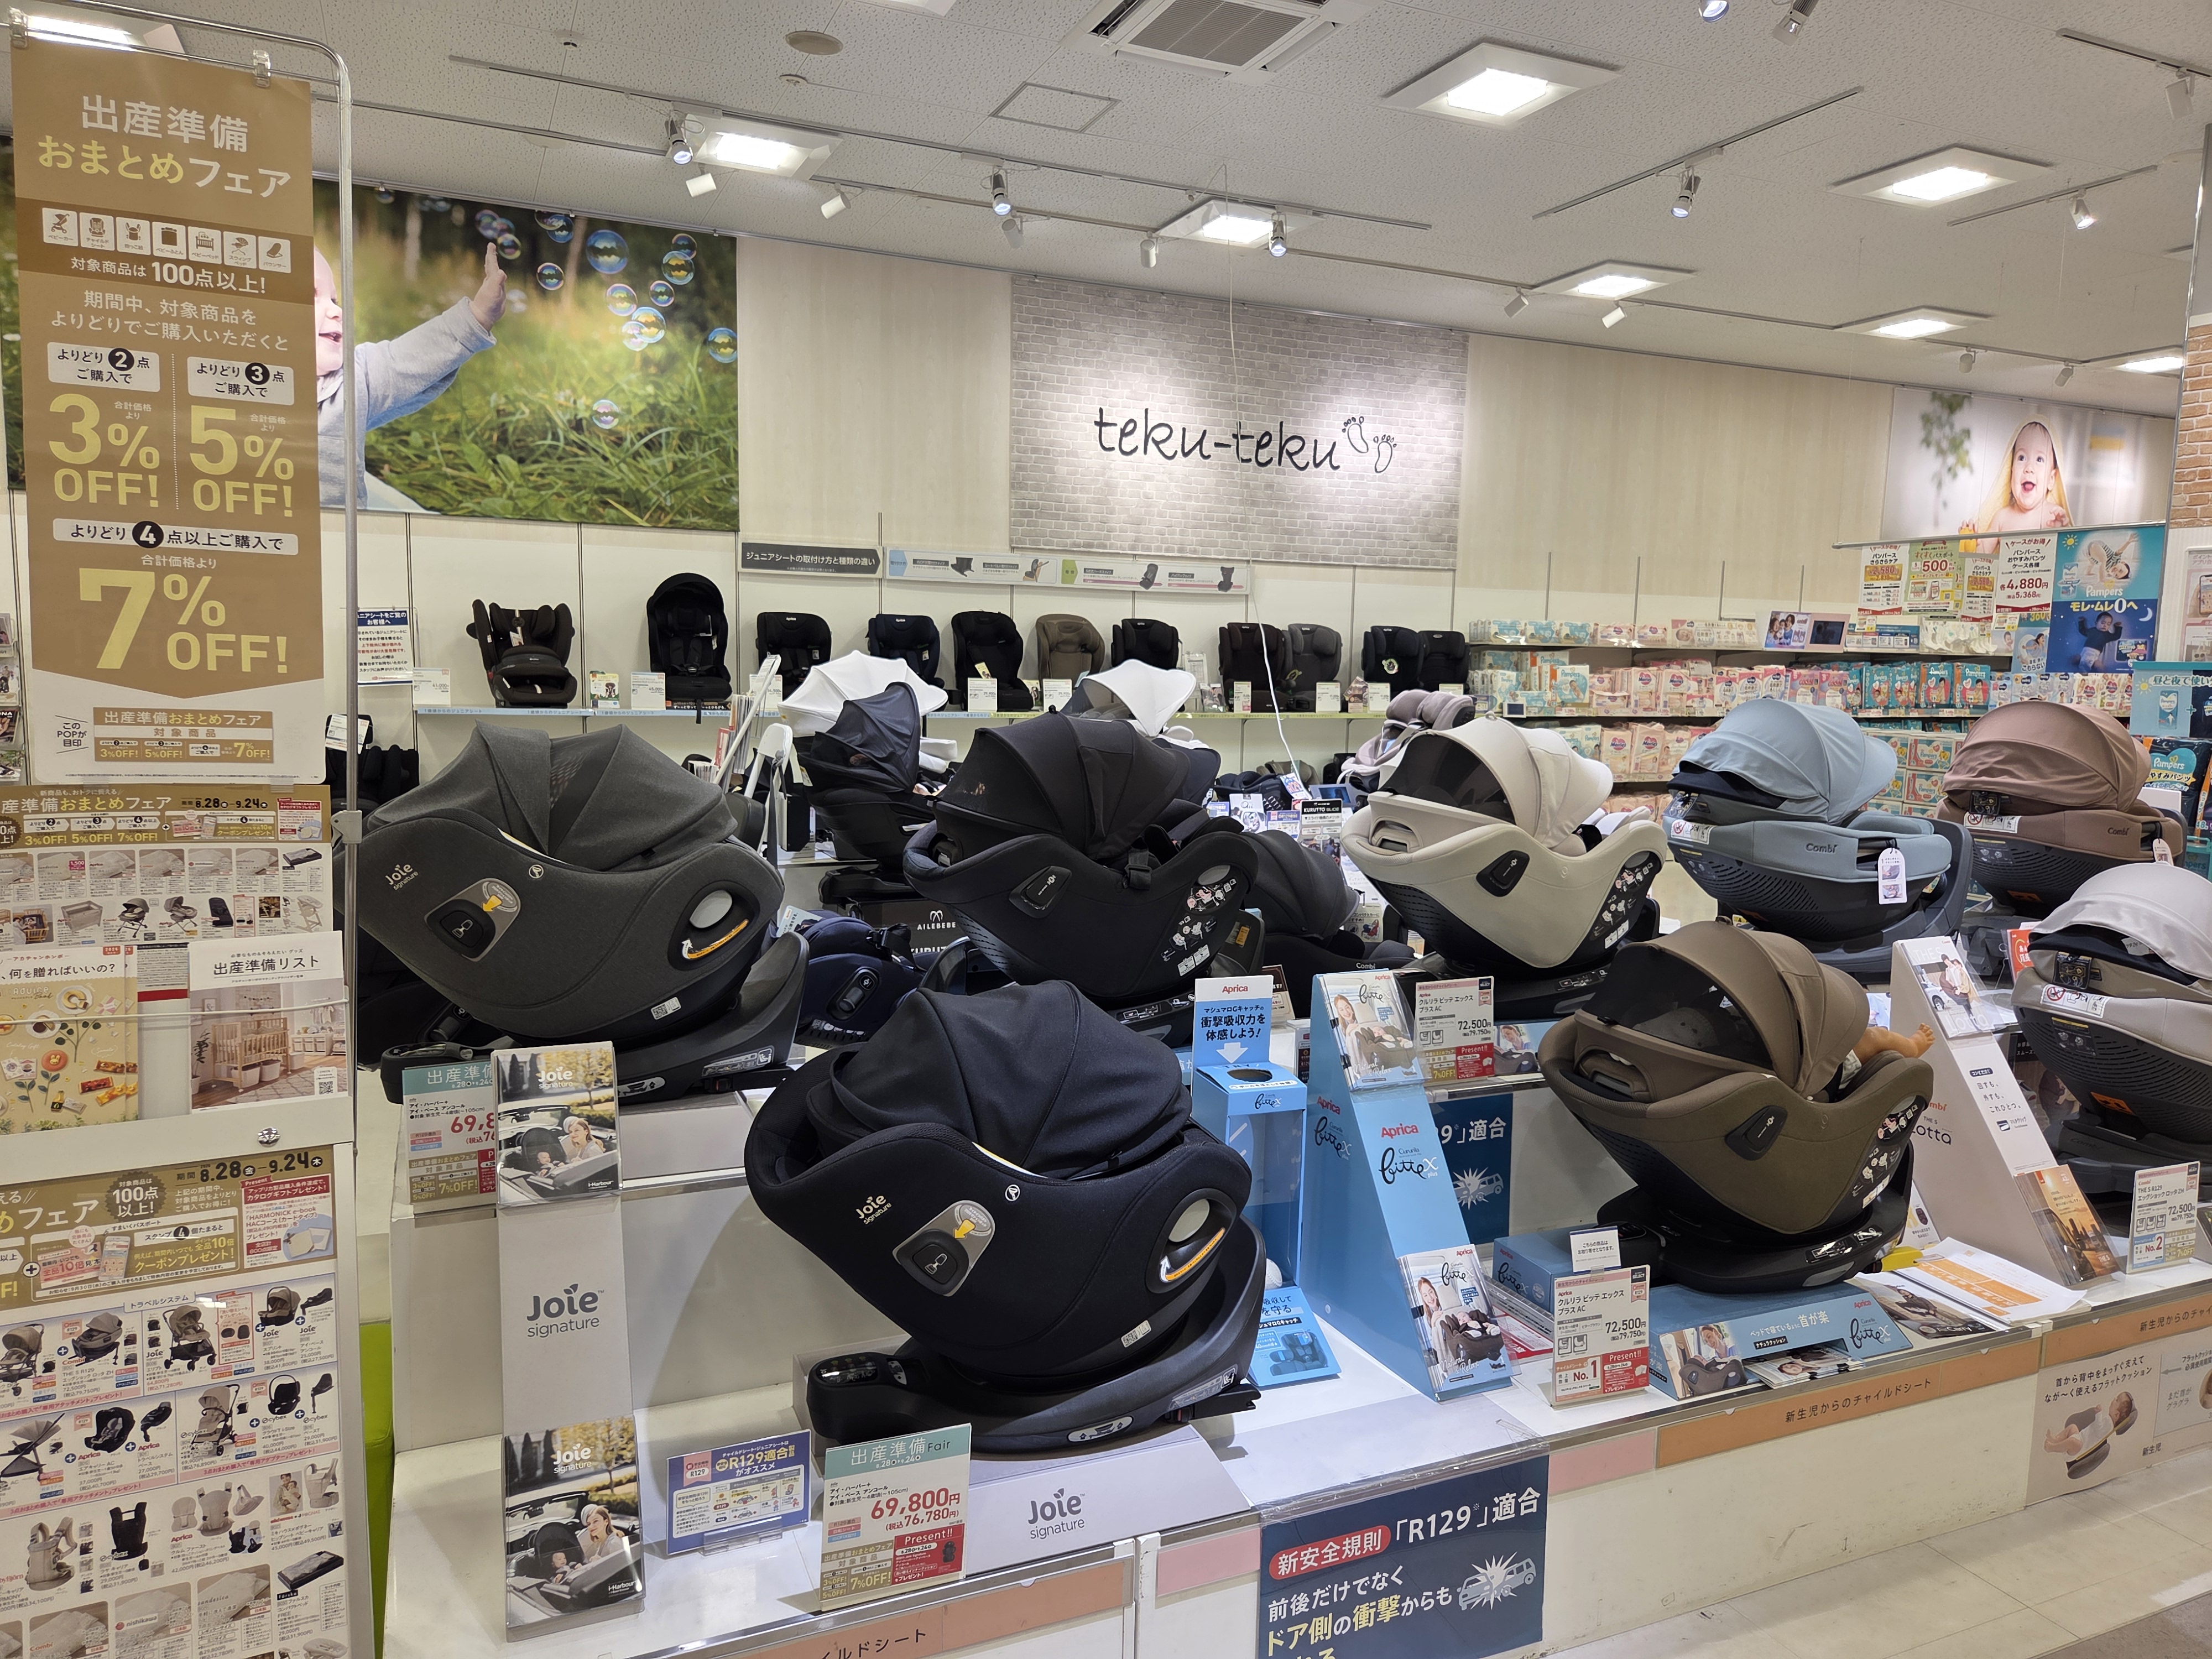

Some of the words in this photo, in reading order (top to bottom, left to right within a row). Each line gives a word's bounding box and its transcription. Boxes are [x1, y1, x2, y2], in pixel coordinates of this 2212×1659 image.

[82, 95, 248, 153] 出産準備
[38, 135, 291, 197] おまとめフェア
[84, 289, 257, 325] 期間中、対象商品を
[51, 310, 289, 351] よりどりでご購入いただくと
[76, 368, 133, 384] ご購入で
[215, 381, 269, 398] ご購入で
[113, 401, 152, 413] 合計価格
[249, 414, 287, 425] 合計価格
[49, 393, 160, 469] 3%
[190, 405, 295, 481] 5%
[1094, 407, 1340, 472] teku-teku
[54, 468, 159, 508] OFF!
[192, 479, 293, 518] OFF!
[2010, 538, 2046, 547] ケースがお得
[141, 554, 217, 570] 合計価格より
[746, 551, 876, 566] ジュニアシートの取付け方と種類の違い
[1922, 560, 1948, 572] 500
[2000, 577, 2049, 591] 各4,880円
[2086, 585, 2124, 598] Pampers
[2070, 598, 2138, 613] モレ・ムレ0へ
[79, 567, 227, 670] 7%
[167, 632, 288, 674] OFF!
[62, 722, 81, 731] この
[104, 711, 262, 727] 出産準備おまとめフェア
[57, 730, 88, 739] POPが
[63, 738, 82, 748] 目印
[2153, 757, 2185, 770] Pampers
[2150, 771, 2192, 782] やすみパンツ
[2107, 827, 2131, 836] Combi
[1806, 842, 1839, 854] Combi
[385, 862, 414, 886] Joie
[393, 870, 419, 891] signature
[917, 921, 956, 931] AILEBEBE
[213, 955, 319, 975] 出産準備リスト
[1222, 984, 1248, 994] Aprica
[1204, 1005, 1264, 1013] マシュマロGキャッチの
[1418, 998, 1438, 1006] クルリラ
[1201, 1013, 1266, 1029] 衝撃吸収力を
[1458, 1018, 1491, 1031] 72,500円
[1206, 1027, 1261, 1041] 体感しよう!
[538, 1066, 573, 1084] Joie
[1433, 1069, 1456, 1079] 7%OFF!
[538, 1079, 573, 1090] signature
[409, 1107, 439, 1115] アイ・ベース
[1317, 1095, 1340, 1115] Aprica
[1989, 1103, 2022, 1113] これひとつ。
[1381, 1123, 1420, 1139] Aprica
[119, 1178, 153, 1187] 対象商品は
[245, 1177, 268, 1186] Present
[439, 1180, 478, 1194] 7%OFF!
[112, 1187, 159, 1204] 100点
[175, 1185, 223, 1197] 上記の期間中、
[175, 1190, 237, 1204] 対象商品をよりどり
[247, 1185, 327, 1202] カタログギフトプレゼント!
[117, 1201, 154, 1218] 以上!
[175, 1199, 231, 1212] ご購入でお得に!
[855, 1195, 887, 1220] Joie
[2168, 1202, 2195, 1216] 72,500円
[863, 1202, 892, 1225] signature
[246, 1230, 278, 1240] プレゼント!
[1578, 1245, 1615, 1256] お取り寄せとなります。
[1582, 1240, 1609, 1249] こちらの商品は
[1455, 1248, 1474, 1257] Aprica
[1499, 1248, 1514, 1260] Aprica
[135, 1248, 234, 1273] クーポンプレゼント!
[131, 1295, 189, 1309] トラベルシステム
[527, 1283, 599, 1322] Joie
[1262, 1295, 1292, 1306] 吸収して
[1558, 1297, 1582, 1307] クルリラ
[1601, 1290, 1624, 1300] エックス
[1853, 1299, 1872, 1310] Aprica
[1261, 1305, 1292, 1317] を守る
[1558, 1307, 1575, 1316] プラス
[300, 1325, 316, 1334] Joie
[527, 1316, 600, 1338] signature
[1605, 1317, 1646, 1334] 72,500円
[263, 1329, 280, 1338] Joie
[1610, 1329, 1646, 1342] (税込79,750円)
[146, 1349, 164, 1358] Joie
[1609, 1350, 1642, 1361] Present!!
[1573, 1359, 1597, 1382] No.1
[2055, 1355, 2145, 1387] 首から背中をまっすぐ支えて
[2044, 1367, 2153, 1403] なが〜く使えるフラットクッション
[2168, 1387, 2192, 1400] まだ首が
[1785, 1378, 1932, 1425] 新生児からのチャイルドシート
[2166, 1397, 2189, 1411] グラグラ
[138, 1442, 160, 1452] Aprica
[553, 1443, 592, 1465] Joie
[722, 1441, 789, 1458] チャイルドシート・ジュニアシートは
[851, 1437, 926, 1466] 出産準備
[927, 1439, 952, 1454] Fair
[2142, 1442, 2162, 1457] 新生児
[78, 1452, 101, 1460] Aprica
[554, 1459, 592, 1475] signature
[690, 1469, 706, 1477] R129
[735, 1462, 775, 1477] がオススメ
[830, 1490, 860, 1501] アイ・ベース
[863, 1485, 889, 1495] アンコール
[871, 1488, 961, 1520] 69,800円
[1028, 1488, 1082, 1525] Joie
[885, 1507, 959, 1531] (税込76,780円)
[1029, 1517, 1086, 1540] signature
[171, 1534, 193, 1543] Aprica
[905, 1528, 953, 1546] Present!!
[824, 1543, 893, 1562] 出産準備おまとめフェア
[1278, 1537, 1382, 1576] 新安全規則
[851, 1571, 891, 1590] 7%OFF!
[1268, 1564, 1404, 1624] 前後だけでなく
[126, 1615, 158, 1627] nishikawa
[1267, 1586, 1453, 1657] ドア側の衝撃からも
[29, 1642, 54, 1652] Combi
